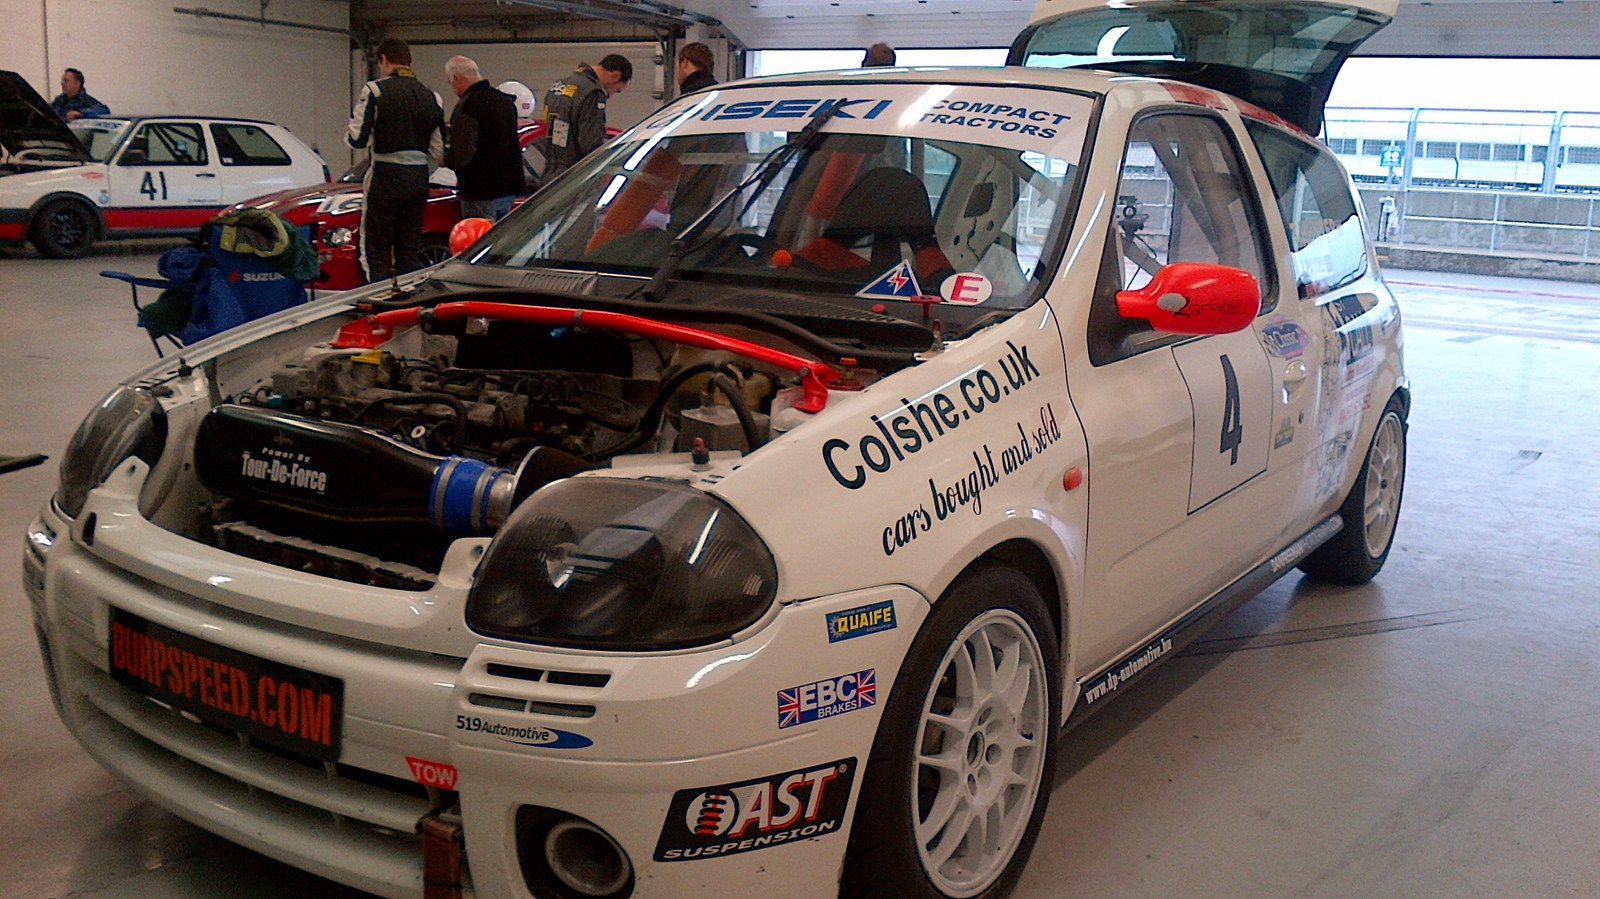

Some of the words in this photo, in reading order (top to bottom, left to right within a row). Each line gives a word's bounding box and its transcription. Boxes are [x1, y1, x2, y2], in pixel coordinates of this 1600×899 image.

[699, 98, 893, 121] ISEKI
[932, 99, 1071, 125] COMPACT
[919, 113, 1058, 139] TRACTORS
[140, 171, 167, 200] 41
[242, 272, 286, 282] SUZUK
[950, 275, 984, 303] E
[822, 340, 1040, 489] Colshe.co.uk
[1219, 354, 1242, 465] 4
[242, 452, 327, 491] Tour-De-Force
[882, 504, 931, 556] cars
[929, 444, 999, 520] bought
[1001, 422, 1033, 476] and
[1032, 402, 1061, 455] sold
[837, 606, 892, 634] QUAIFE
[112, 620, 332, 746] BURPSPEED.COM
[800, 675, 857, 712] EBC
[818, 700, 857, 718] BRAKES
[412, 761, 455, 786] TOW
[727, 766, 838, 838] AST
[663, 819, 836, 859] SUSPENSION
